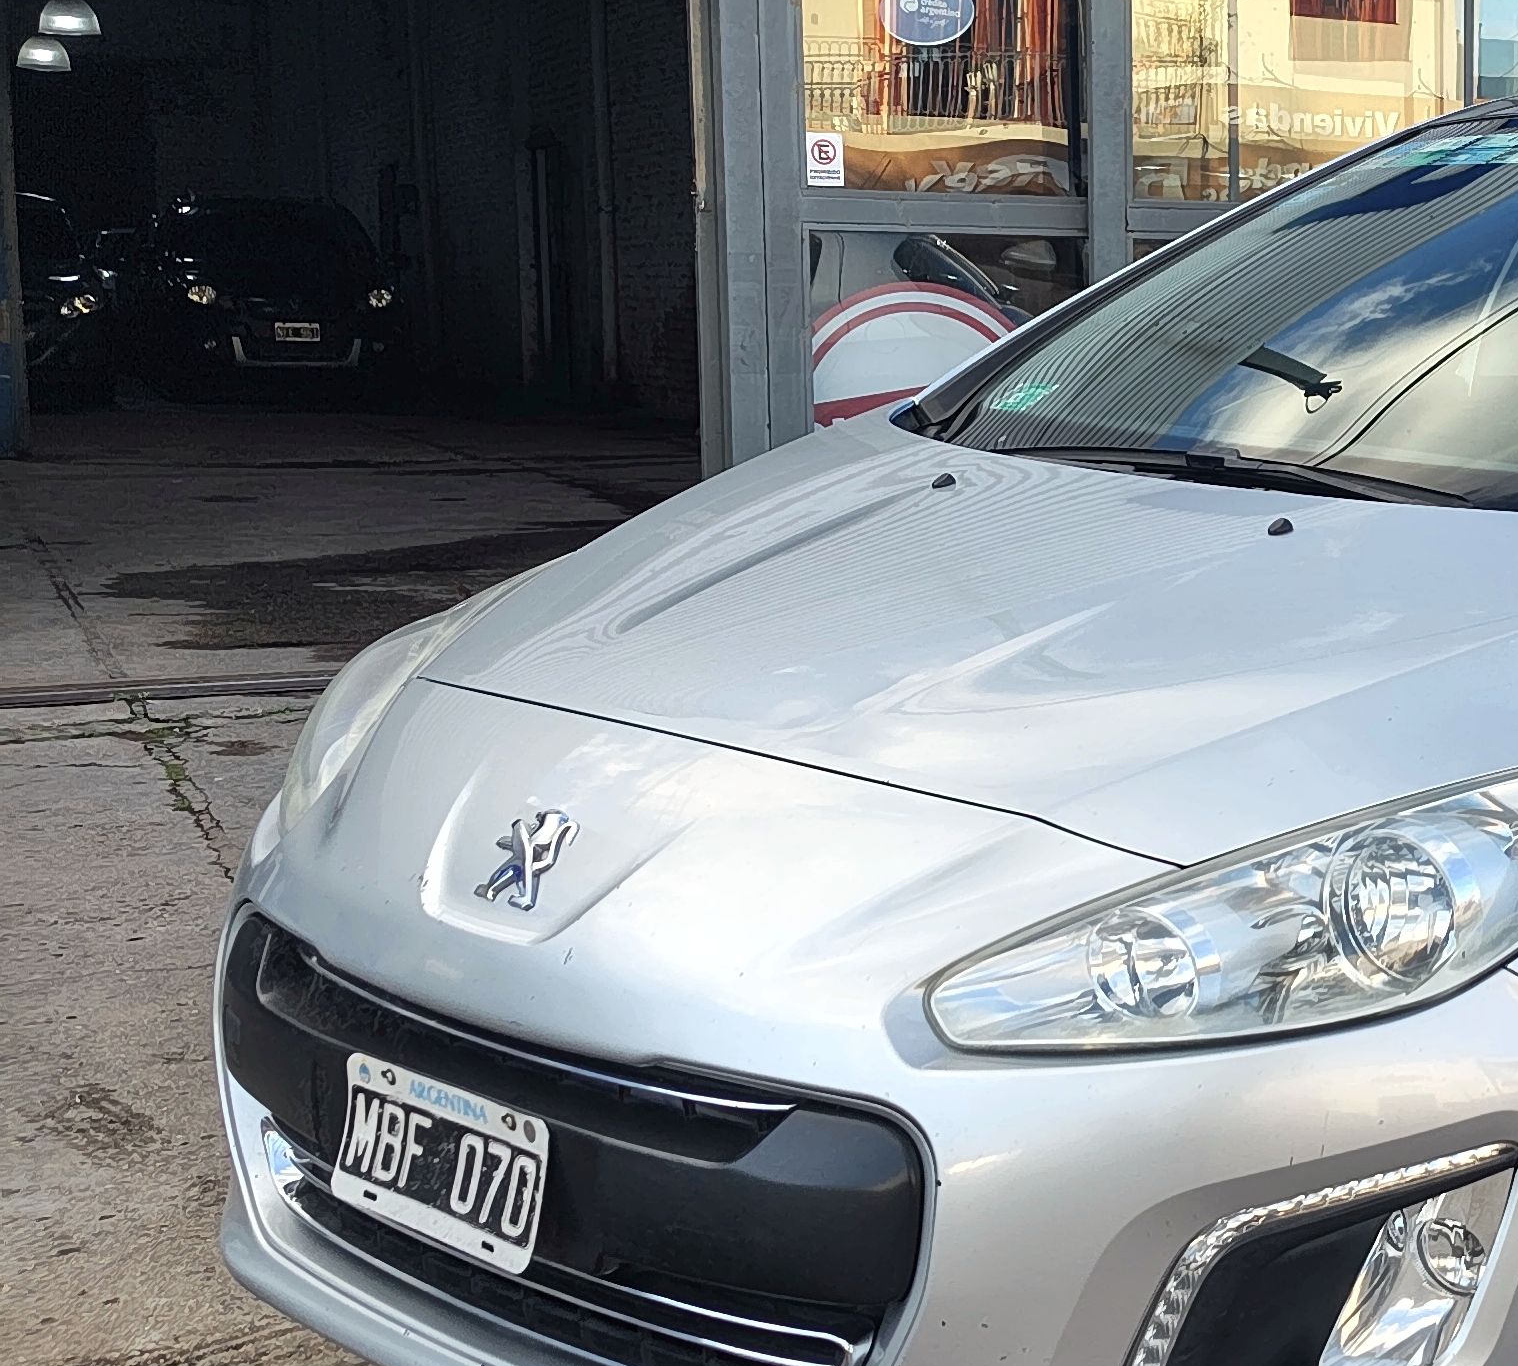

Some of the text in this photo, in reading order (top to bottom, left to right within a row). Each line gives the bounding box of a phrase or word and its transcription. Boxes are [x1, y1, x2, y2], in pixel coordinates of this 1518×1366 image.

[409, 1079, 488, 1125] ARGENTINA
[345, 1092, 537, 1236] MBF 070
